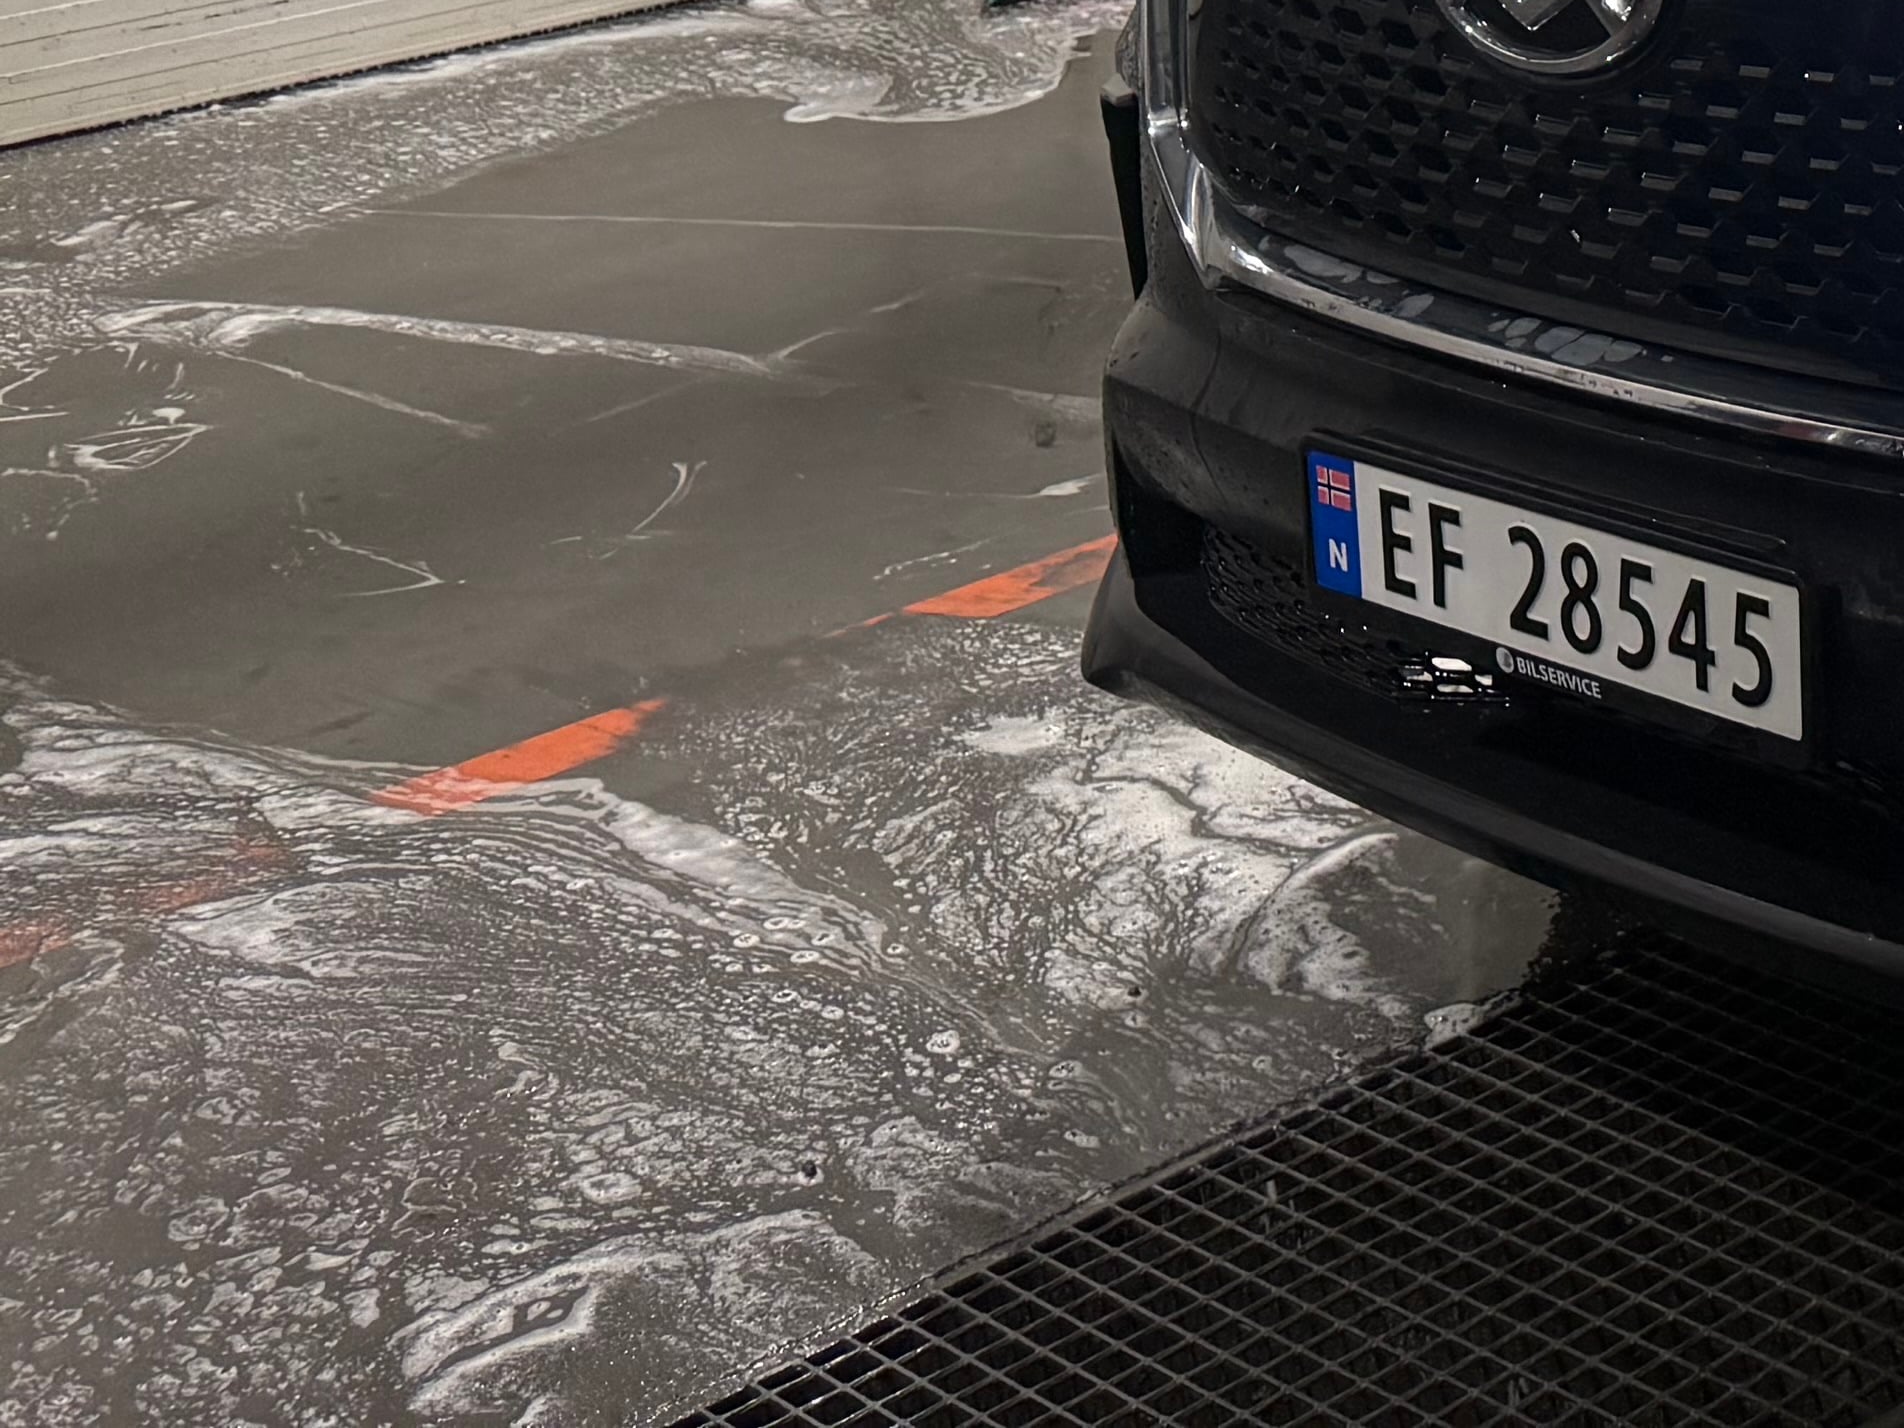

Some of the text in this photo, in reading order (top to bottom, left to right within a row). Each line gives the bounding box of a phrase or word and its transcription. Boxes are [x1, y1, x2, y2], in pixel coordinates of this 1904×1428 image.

[1328, 537, 1349, 573] N
[1378, 486, 1773, 708] EF 28545
[1516, 656, 1602, 699] BILSERVICE
